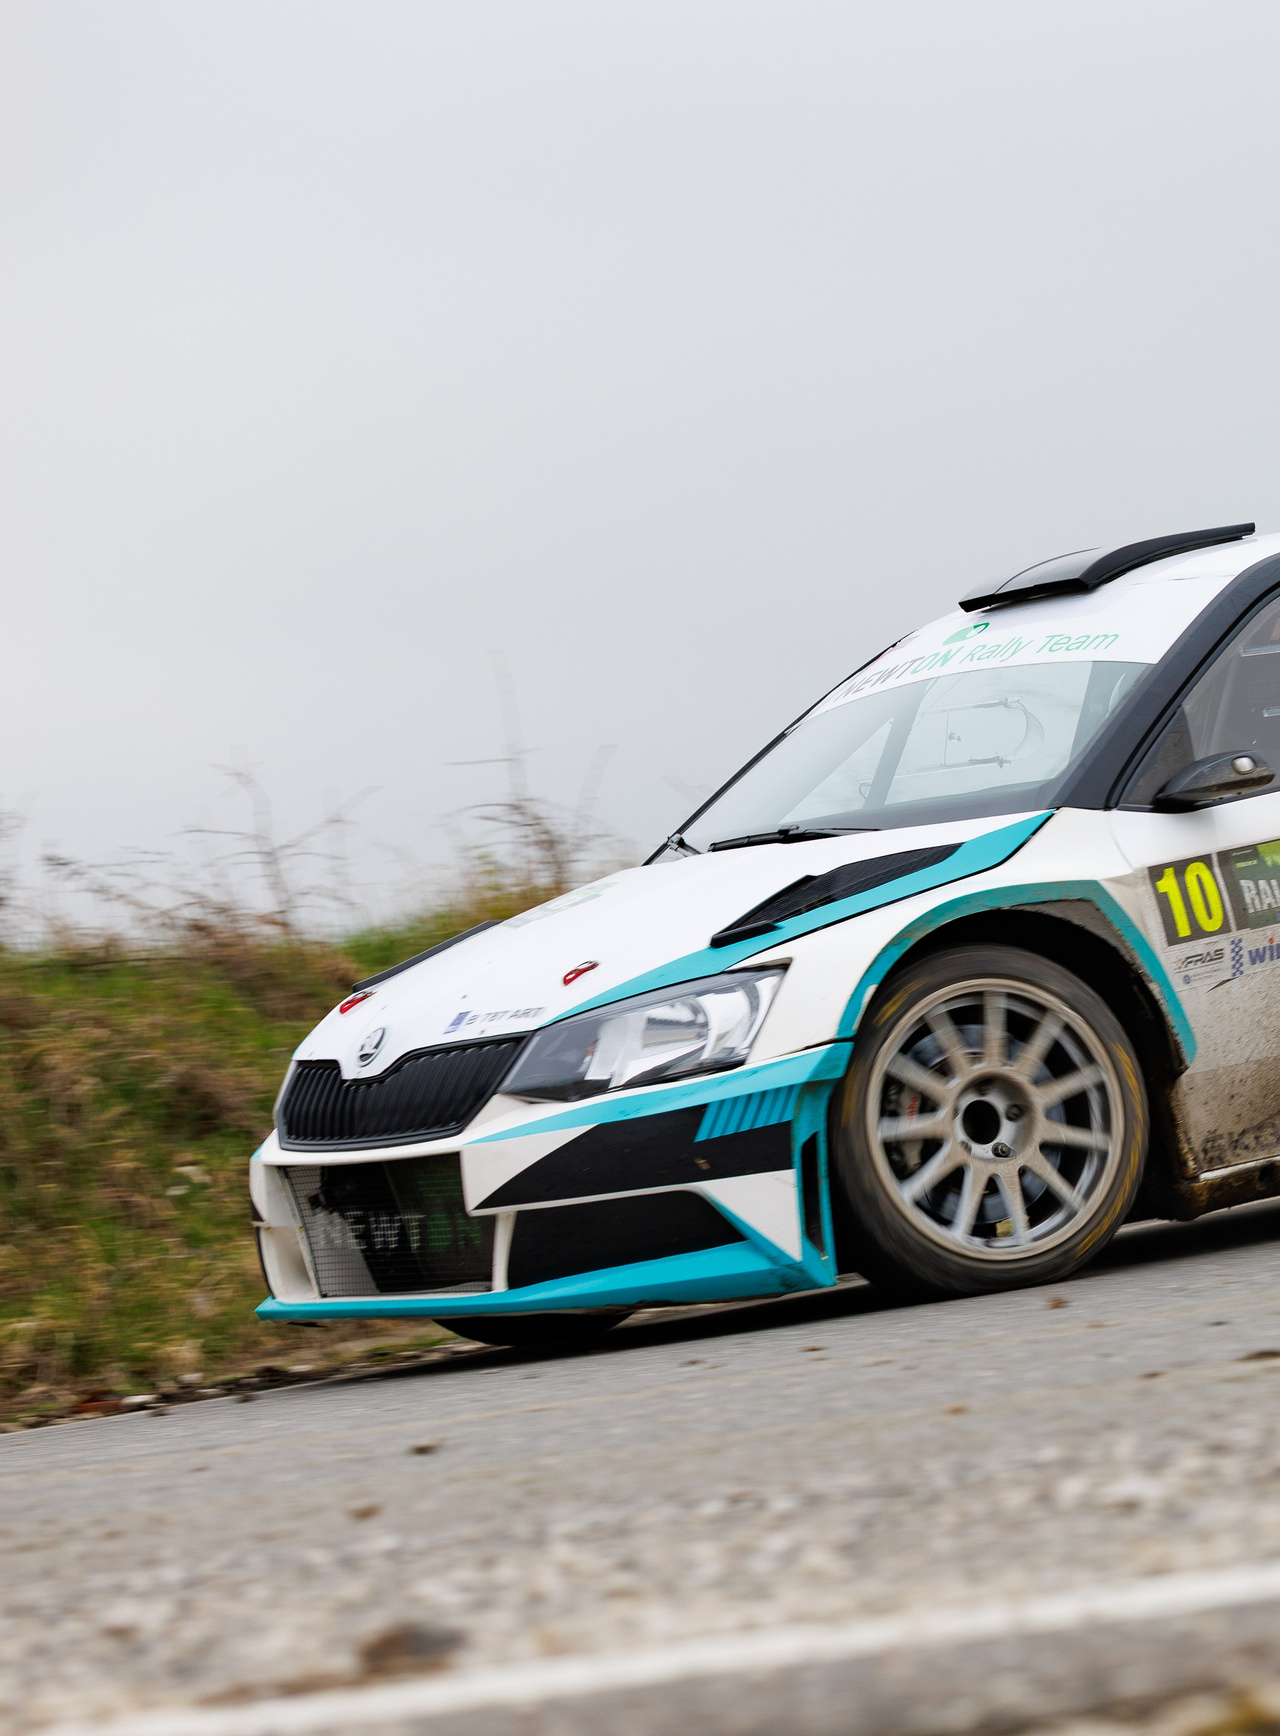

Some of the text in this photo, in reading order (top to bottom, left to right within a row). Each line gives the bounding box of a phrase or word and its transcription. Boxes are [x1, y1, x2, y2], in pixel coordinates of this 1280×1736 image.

[833, 633, 1120, 703] NEWTON Rally Team
[1155, 861, 1224, 938] 10
